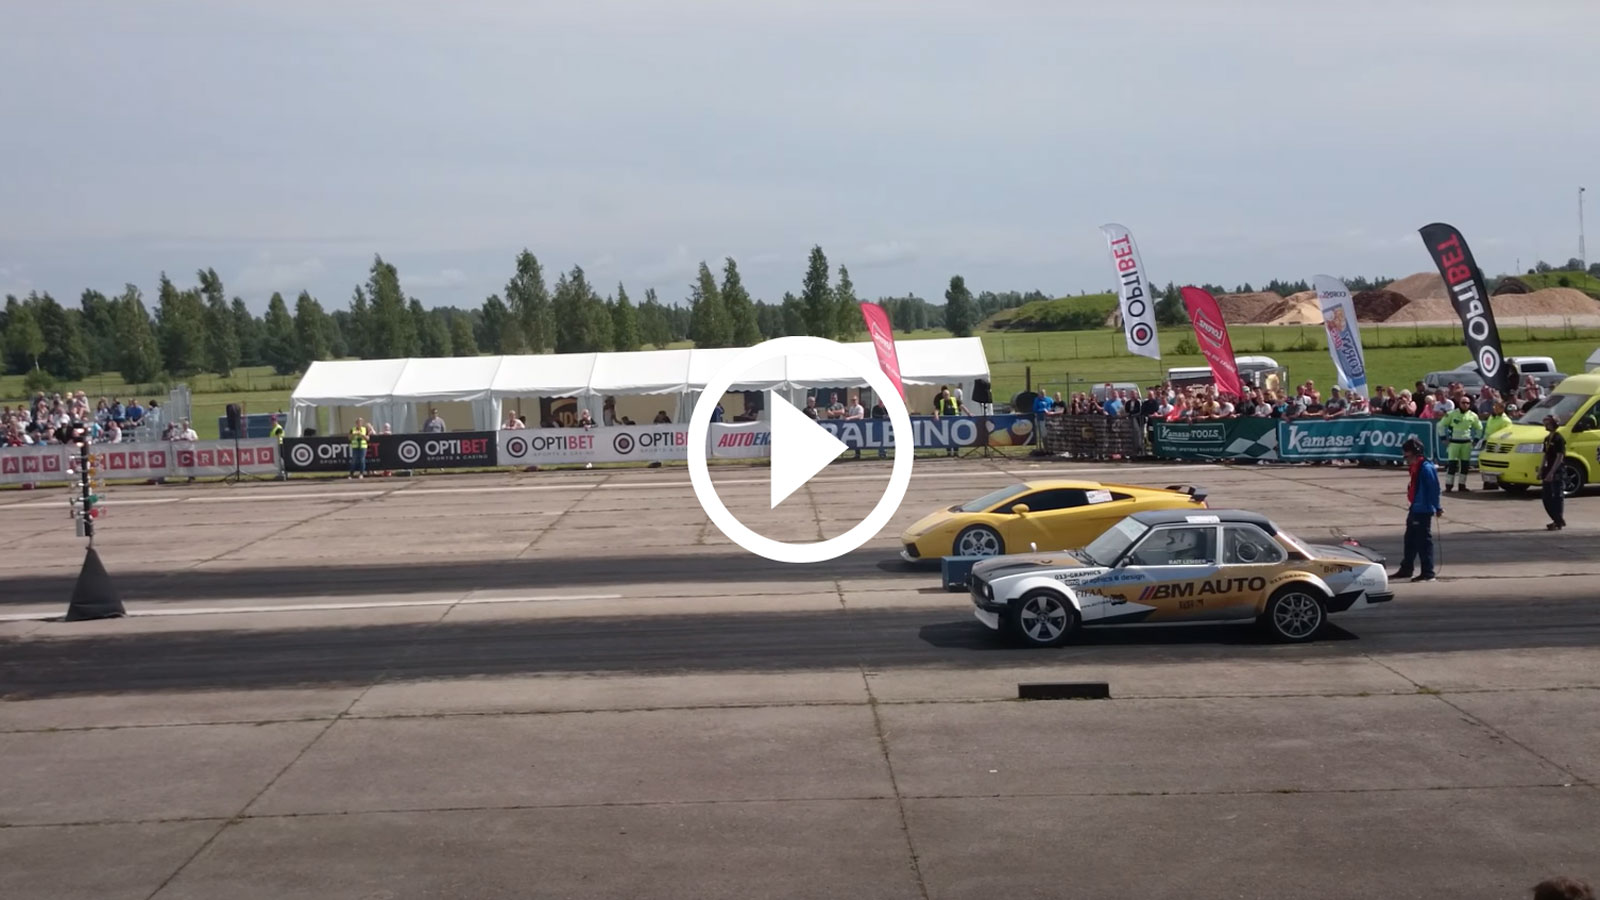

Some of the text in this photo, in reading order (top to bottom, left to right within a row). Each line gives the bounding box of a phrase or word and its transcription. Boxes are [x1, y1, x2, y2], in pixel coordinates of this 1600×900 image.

[424, 438, 488, 456] OPTIBET
[531, 435, 595, 451] OPTIBET
[717, 431, 771, 447] AUTOEK
[178, 448, 272, 466] CRAMO
[317, 442, 380, 459] OPTIET
[1121, 573, 1146, 581] design
[1197, 576, 1266, 596] AUTO
